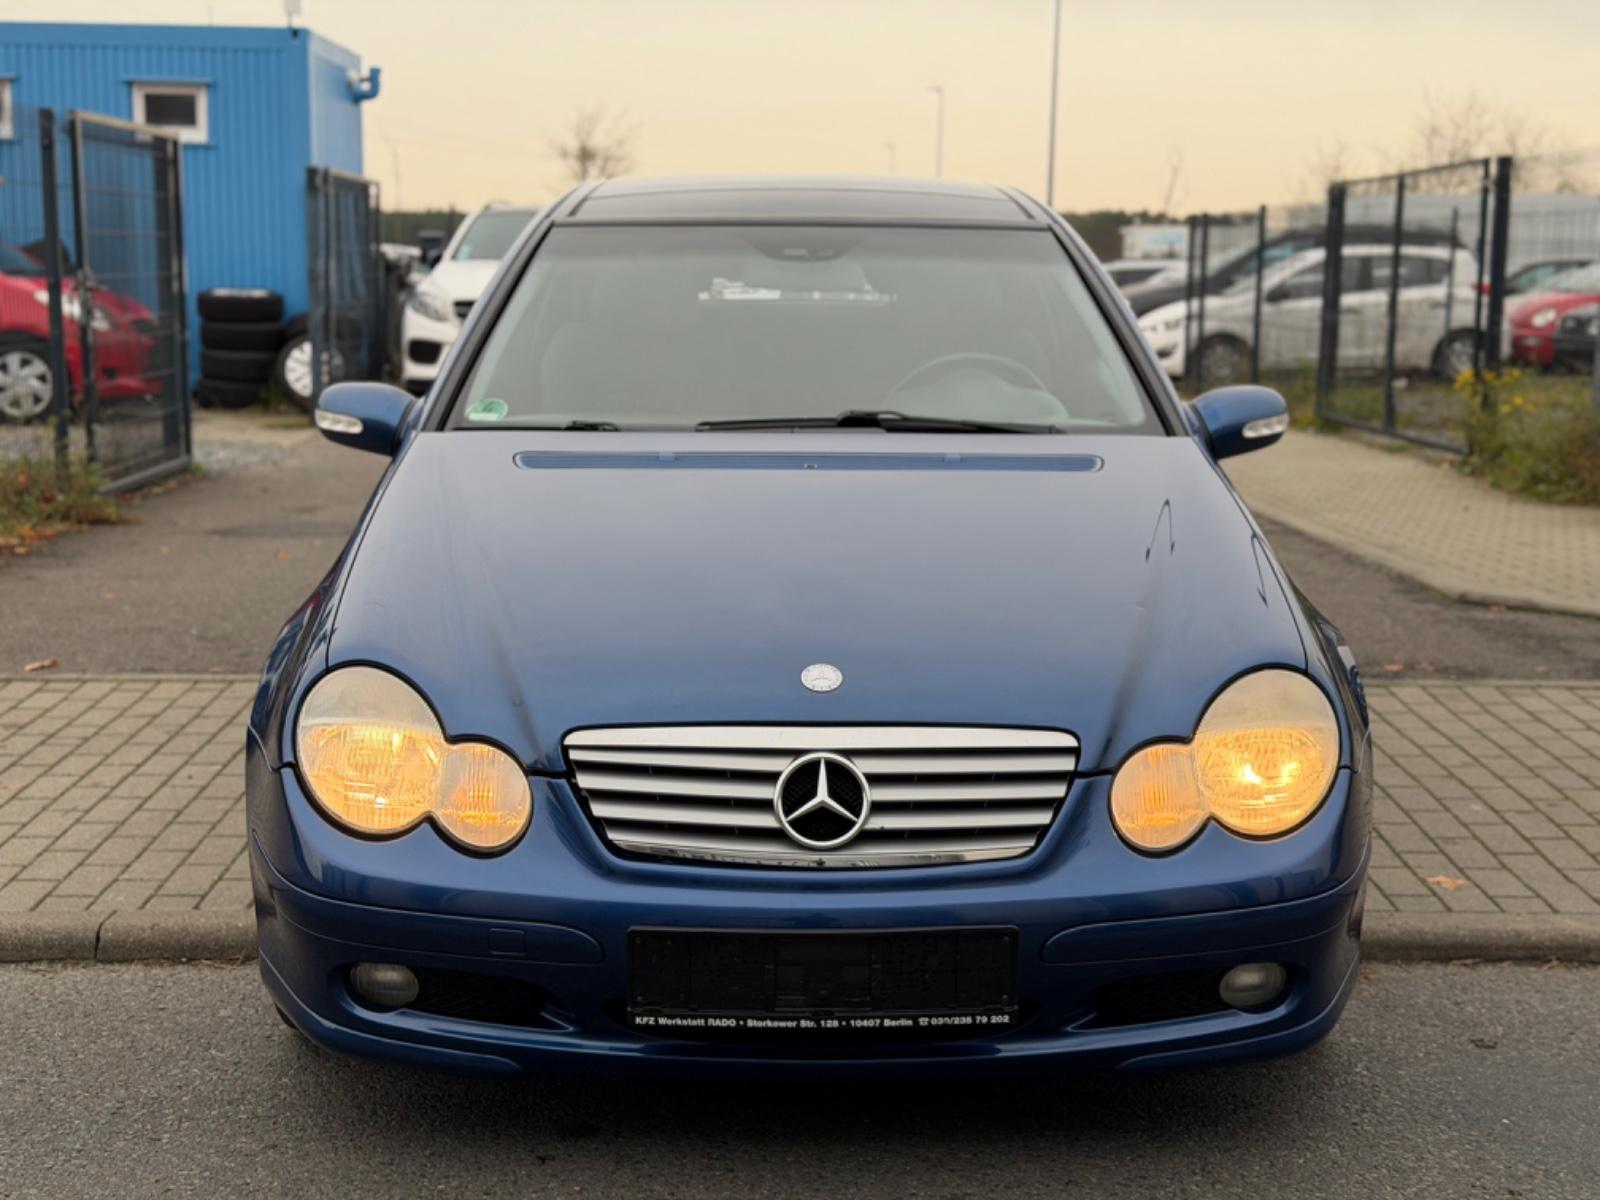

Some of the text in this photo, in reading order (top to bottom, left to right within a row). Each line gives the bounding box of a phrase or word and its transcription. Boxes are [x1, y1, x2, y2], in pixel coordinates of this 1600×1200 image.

[635, 1016, 656, 1025] KFZ
[658, 1017, 706, 1027] Werkstatt
[799, 1019, 818, 1028] Str.
[850, 1018, 881, 1028] 10407
[883, 1018, 913, 1027] Berlin
[990, 1015, 1011, 1024] 202
